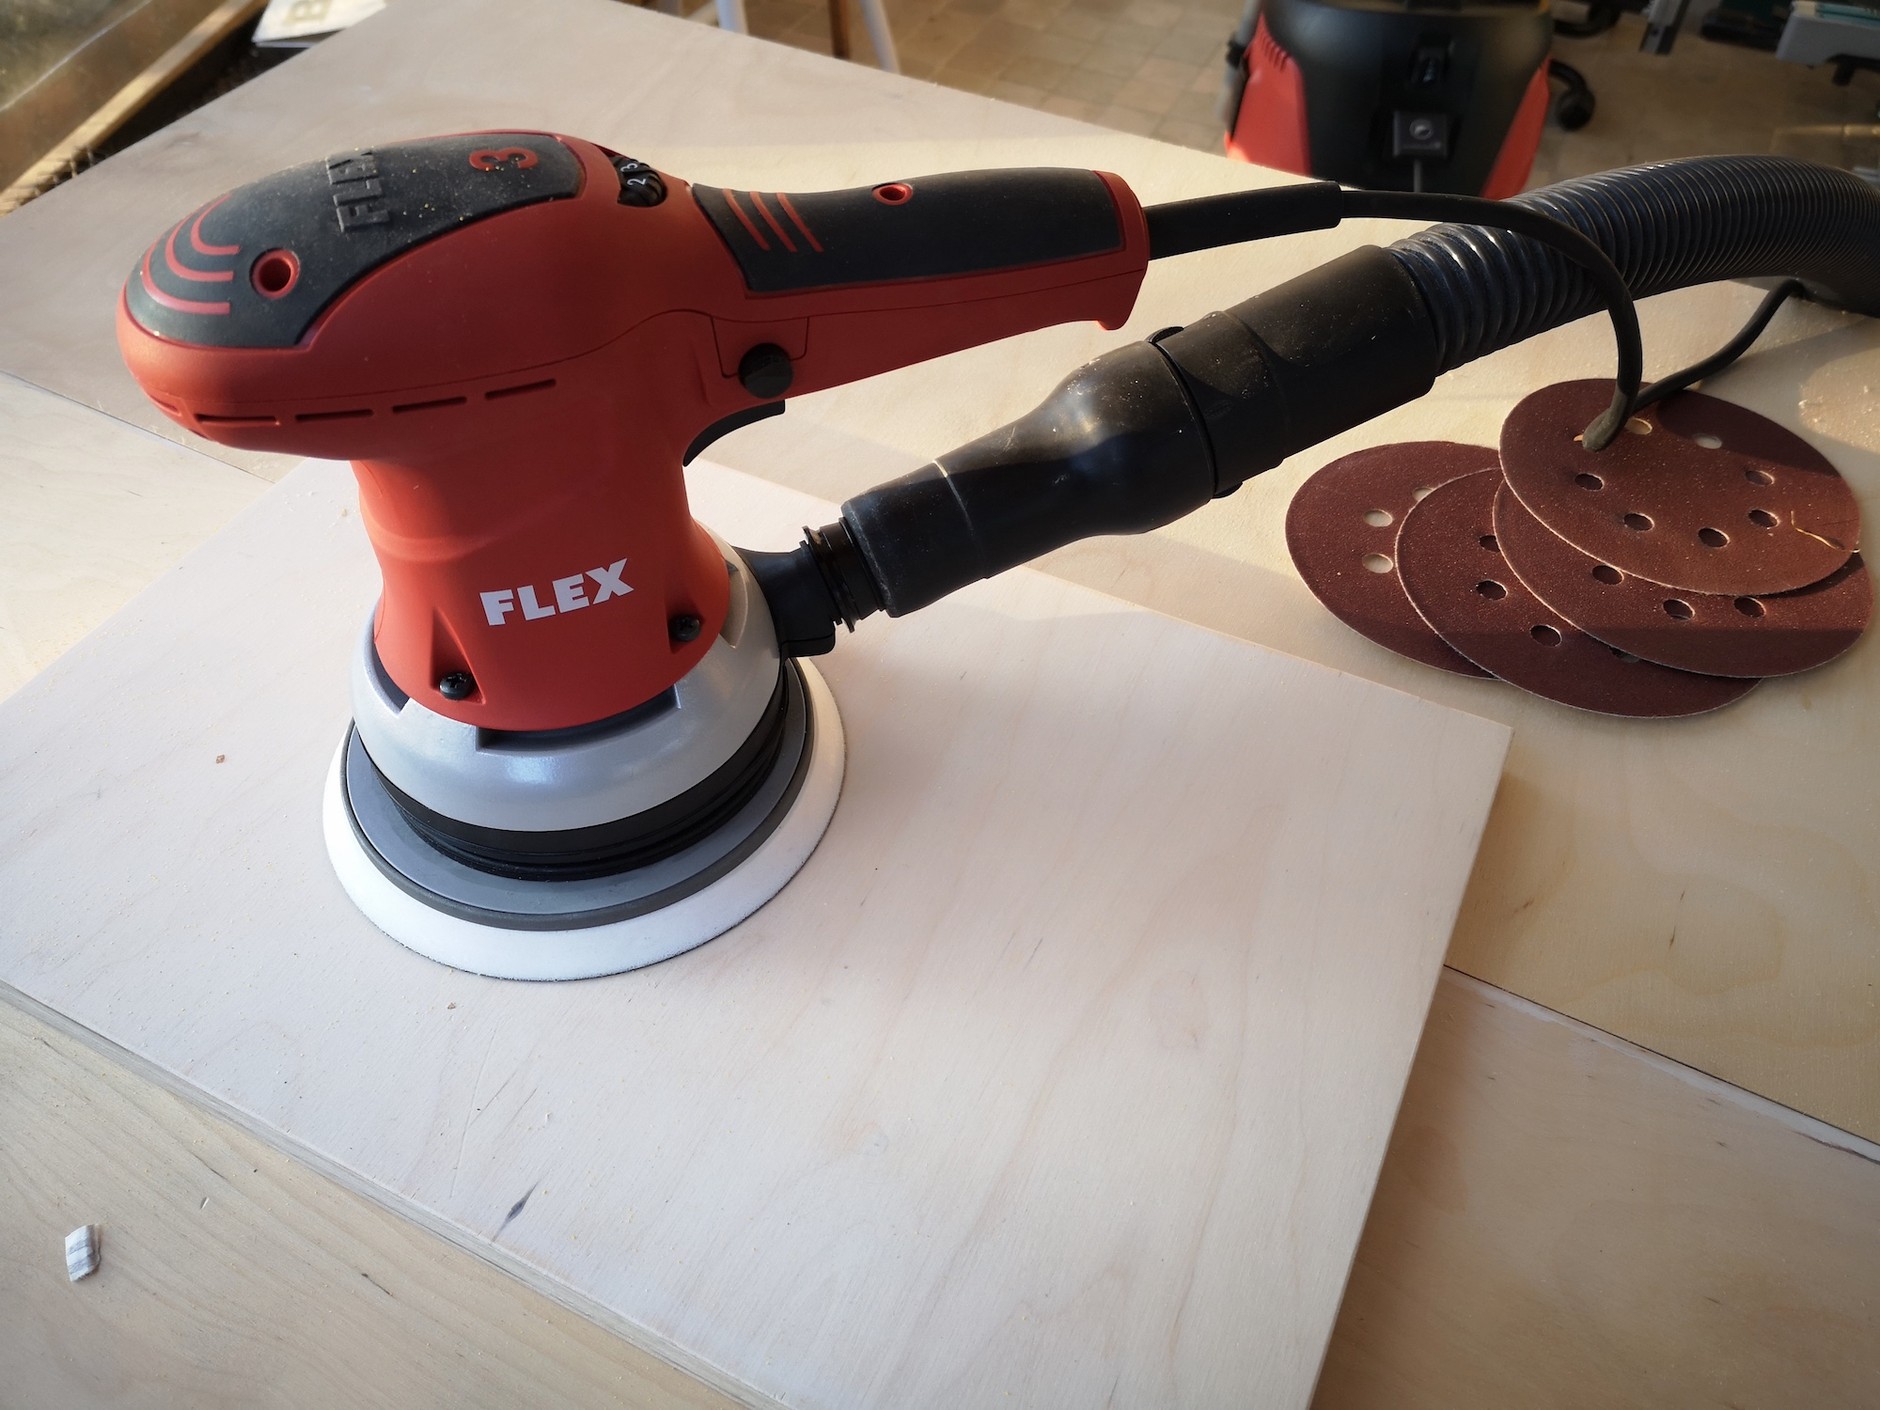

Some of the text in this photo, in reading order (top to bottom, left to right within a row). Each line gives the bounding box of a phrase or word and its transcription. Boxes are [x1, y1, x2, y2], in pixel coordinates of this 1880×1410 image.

[469, 146, 539, 171] 3
[620, 162, 639, 173] 3
[626, 178, 647, 186] 2
[479, 557, 635, 626] FLEX
